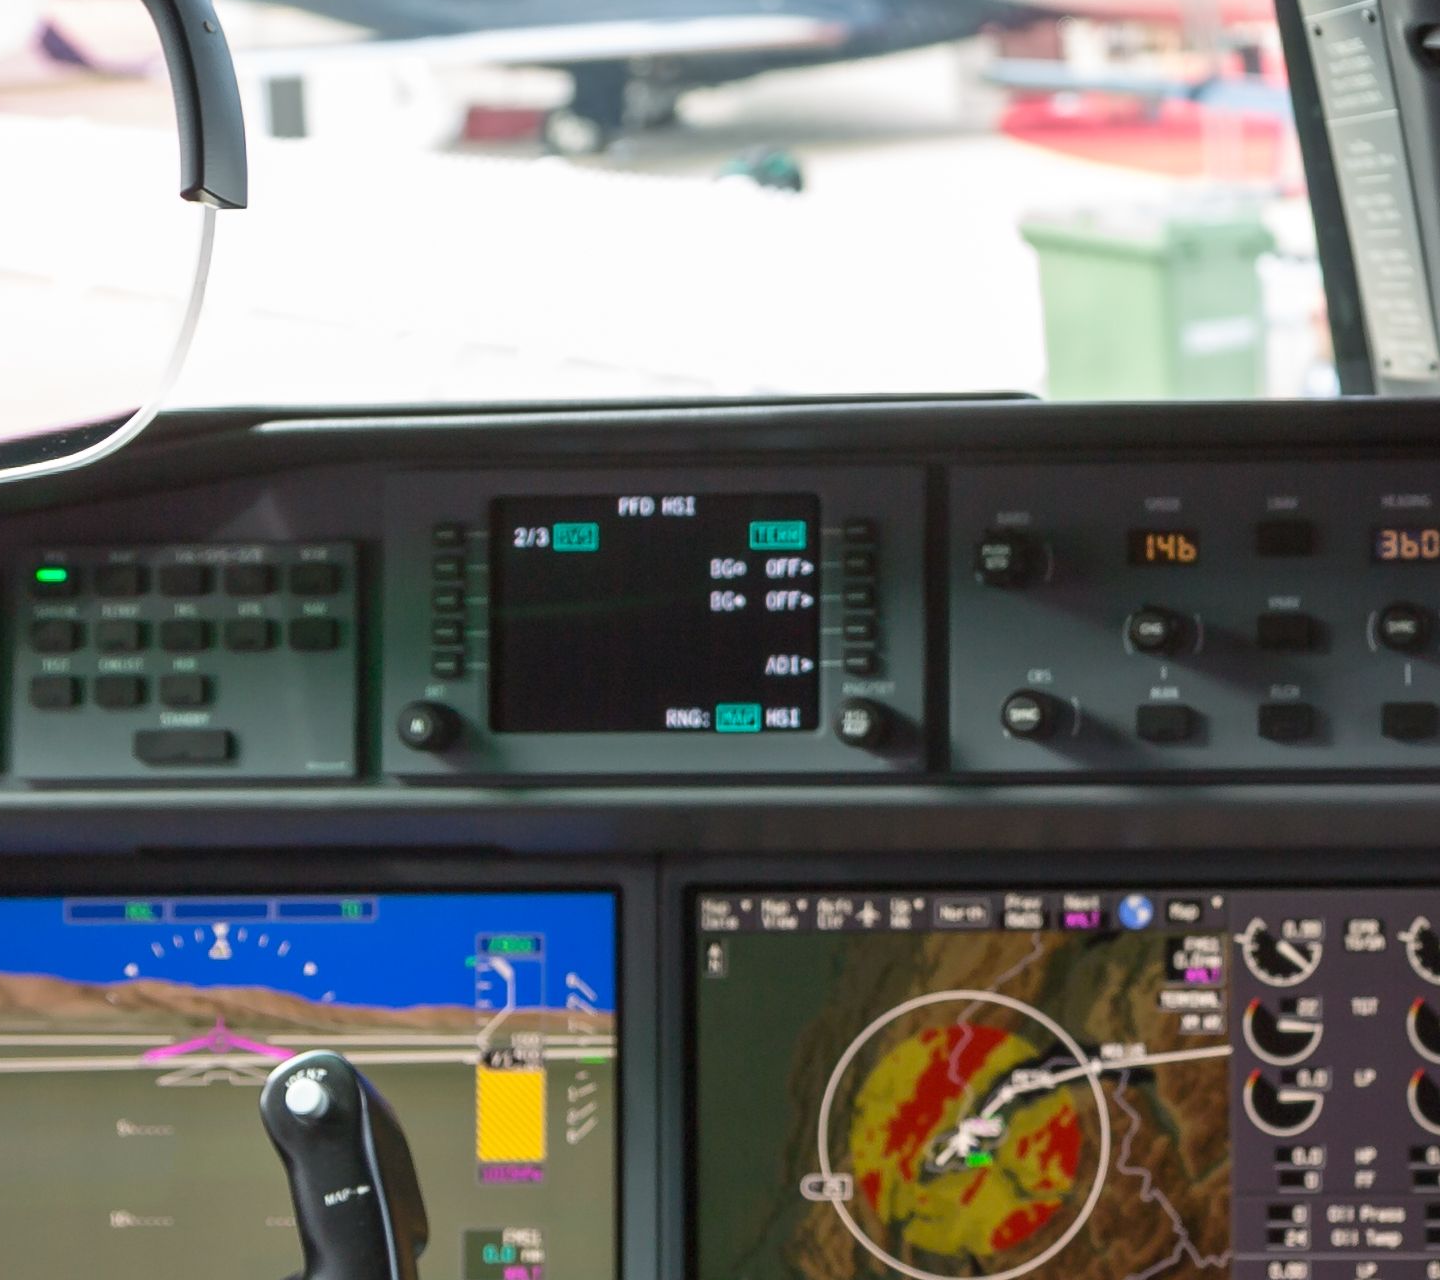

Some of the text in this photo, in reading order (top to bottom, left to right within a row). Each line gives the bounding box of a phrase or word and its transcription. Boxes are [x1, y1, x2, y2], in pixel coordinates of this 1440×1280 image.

[617, 497, 655, 517] PFD
[513, 528, 550, 548] 2/3
[1378, 529, 1440, 560] 360
[324, 1187, 352, 1208] MAP
